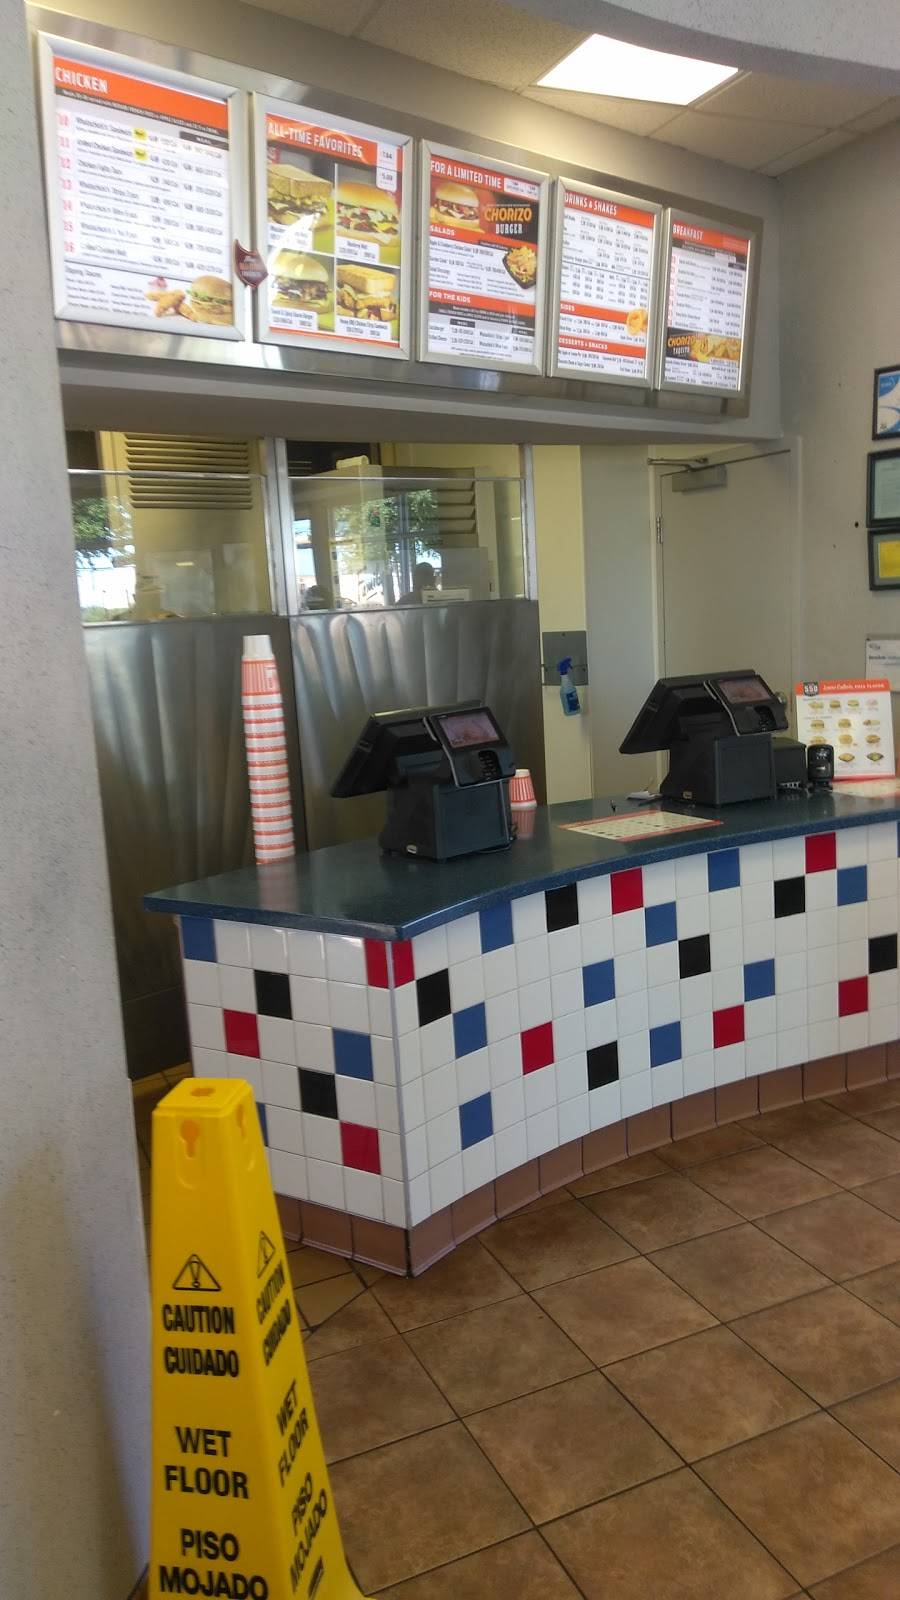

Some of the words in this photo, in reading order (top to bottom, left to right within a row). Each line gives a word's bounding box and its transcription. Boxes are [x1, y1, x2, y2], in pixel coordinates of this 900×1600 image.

[55, 67, 108, 93] CHICKEN
[267, 121, 313, 146] ALL-TIME
[313, 135, 363, 158] FAVORITES
[431, 161, 446, 175] FOR
[447, 166, 453, 176] A
[454, 168, 483, 185] LIMITED
[485, 174, 502, 188] TIME
[485, 207, 532, 222] CHORIZO
[565, 193, 587, 208] DRINKS
[594, 200, 617, 216] SHAKES
[430, 226, 455, 237] SALADS
[496, 223, 522, 234] BURGER
[673, 224, 704, 240] BREAKFAST
[429, 291, 442, 300] FOR
[443, 293, 456, 301] THE
[457, 294, 471, 303] KIDS
[588, 341, 608, 351] SNACKS
[162, 1303, 235, 1334] CAUTION
[164, 1346, 239, 1378] CUIDADO
[175, 1425, 232, 1458] WET
[279, 1408, 309, 1488] FLOOR
[164, 1465, 249, 1501] FLOOR
[292, 1472, 312, 1537] PISO
[180, 1528, 239, 1562] PISO
[159, 1564, 269, 1600] MOJADO
